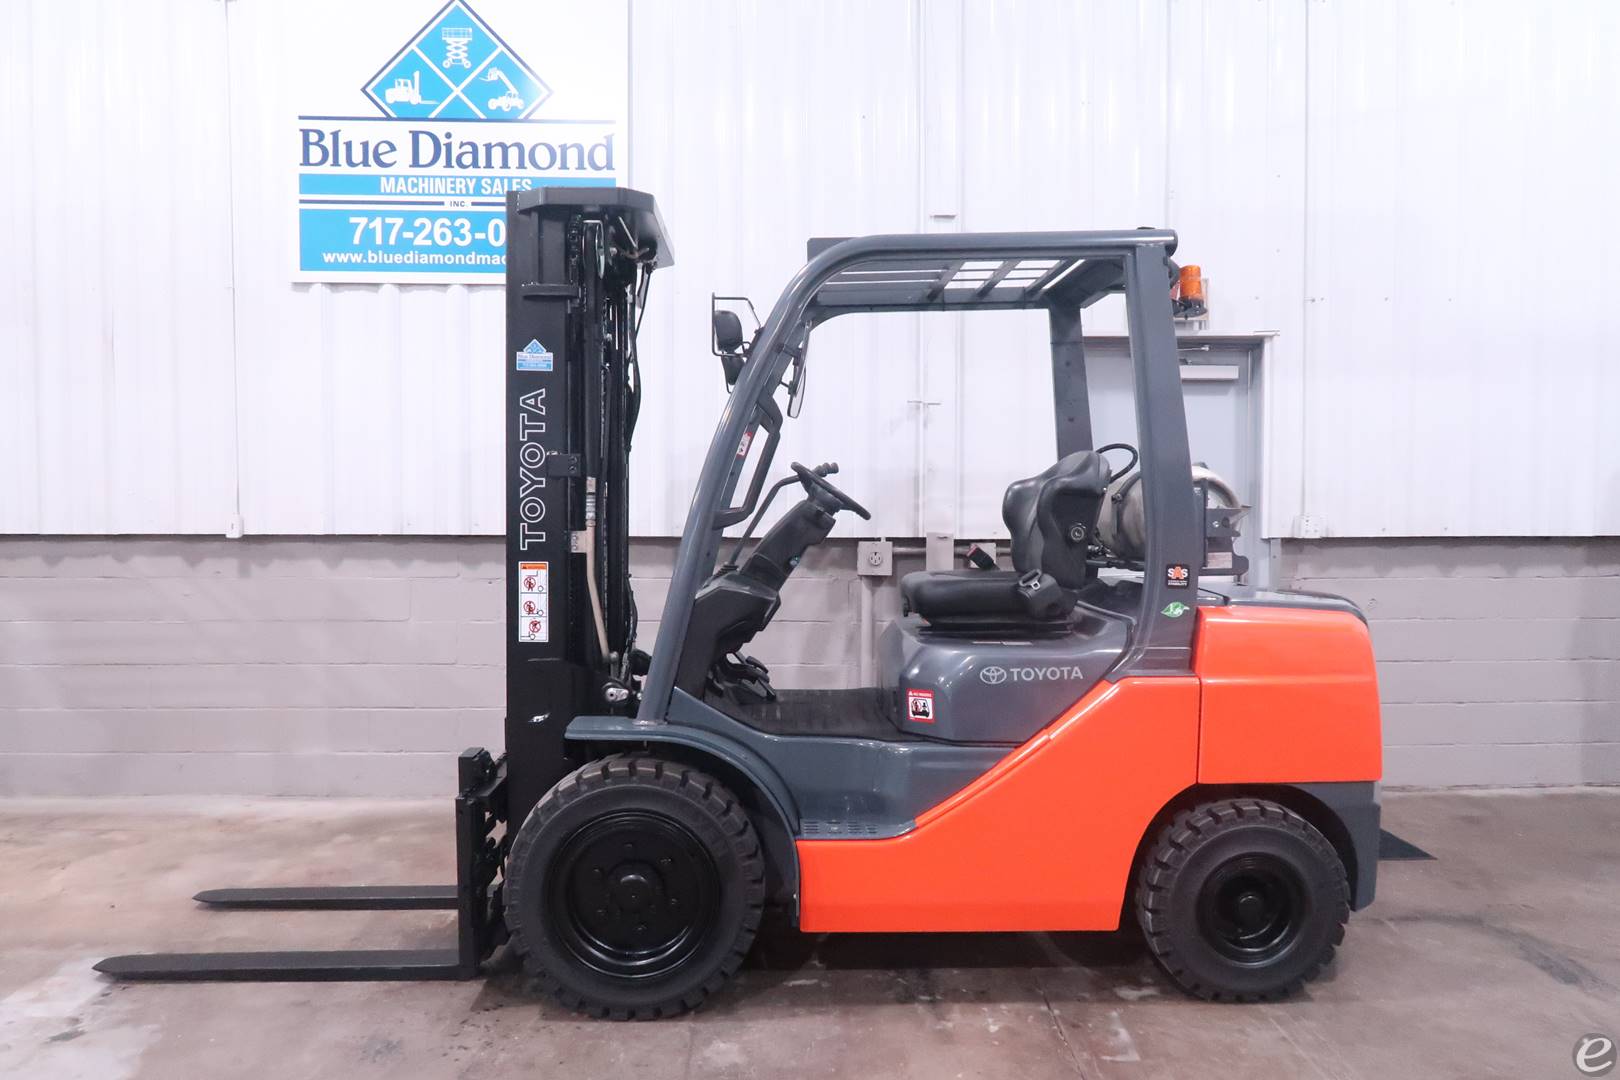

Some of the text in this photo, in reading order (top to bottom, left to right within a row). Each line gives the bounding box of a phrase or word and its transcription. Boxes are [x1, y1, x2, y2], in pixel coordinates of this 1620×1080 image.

[299, 128, 616, 172] Blue Diamond
[380, 176, 532, 195] MACHINERY SALES
[349, 216, 507, 247] 717-263-0
[519, 388, 546, 551] TOYOTA
[1167, 566, 1189, 580] SAS
[1009, 666, 1084, 681] TOYOTA
